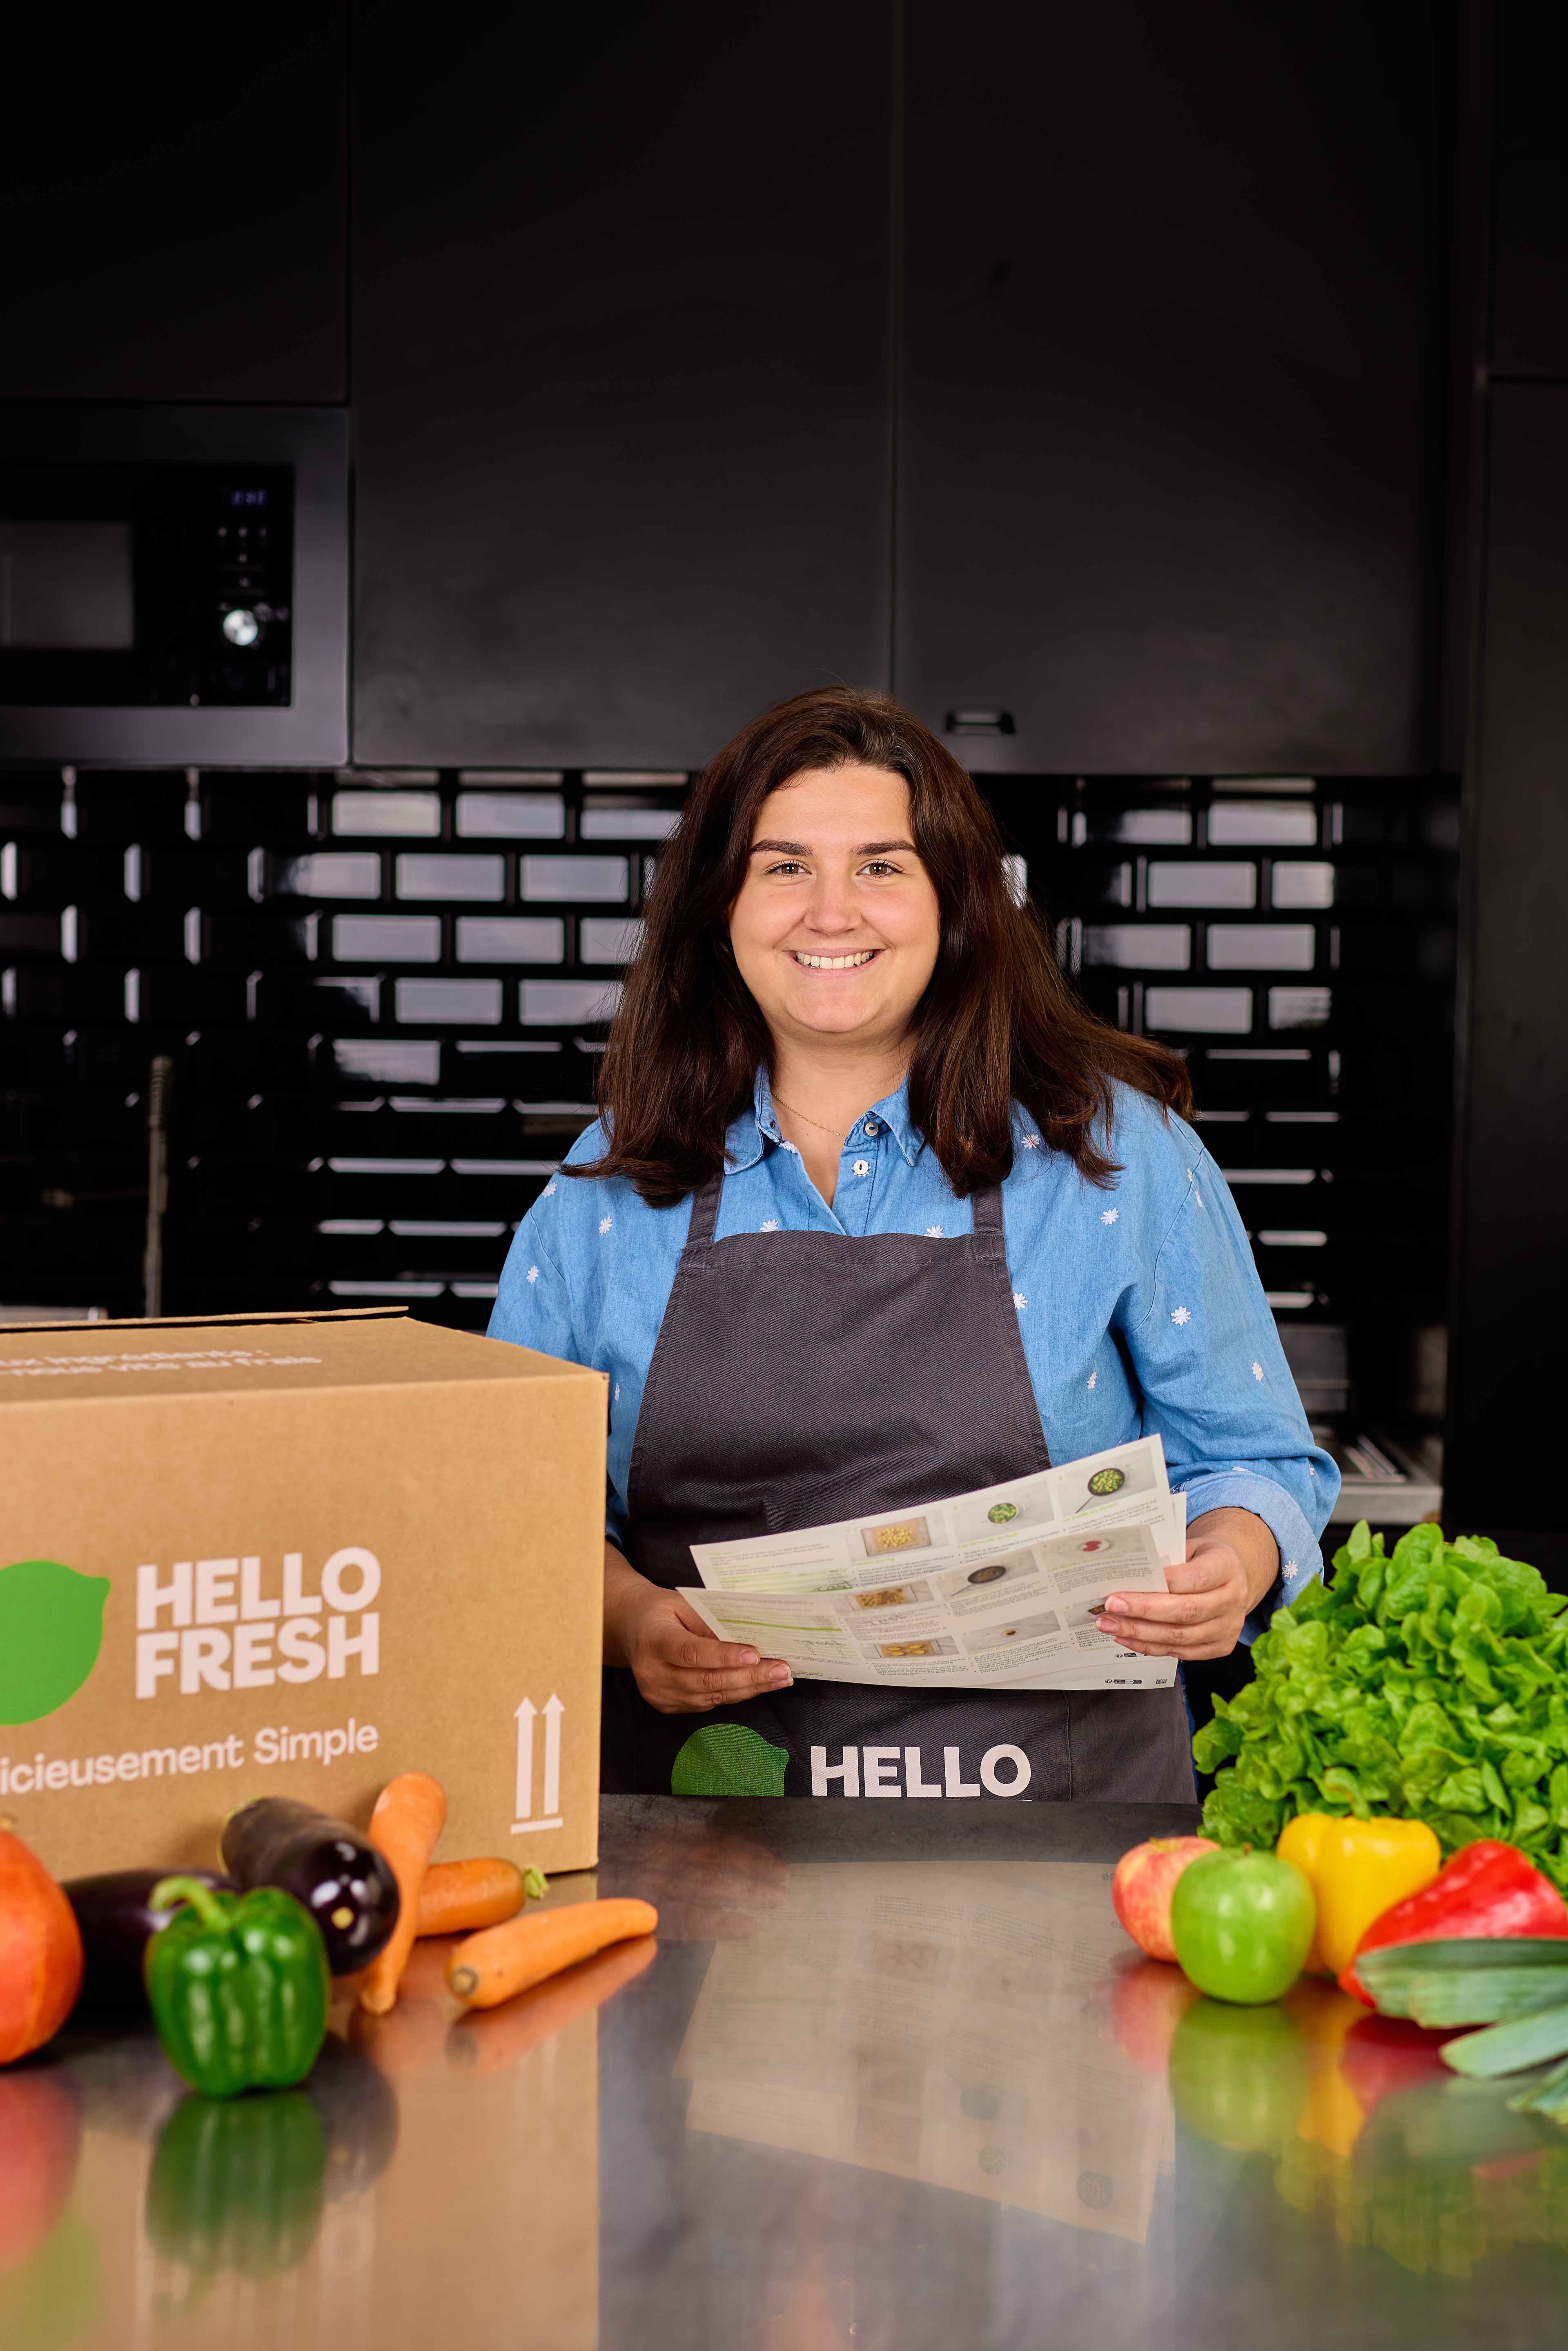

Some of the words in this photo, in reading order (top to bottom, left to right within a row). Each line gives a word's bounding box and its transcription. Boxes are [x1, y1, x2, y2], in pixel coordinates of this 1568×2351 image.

[107, 1362, 180, 1372] vite
[186, 1359, 232, 1368] au
[234, 1355, 323, 1366] frais
[137, 1547, 381, 1630] HELLO
[136, 1612, 380, 1700] FRESH
[254, 1718, 379, 1765] Simple
[811, 1744, 1031, 1797] HELLO
